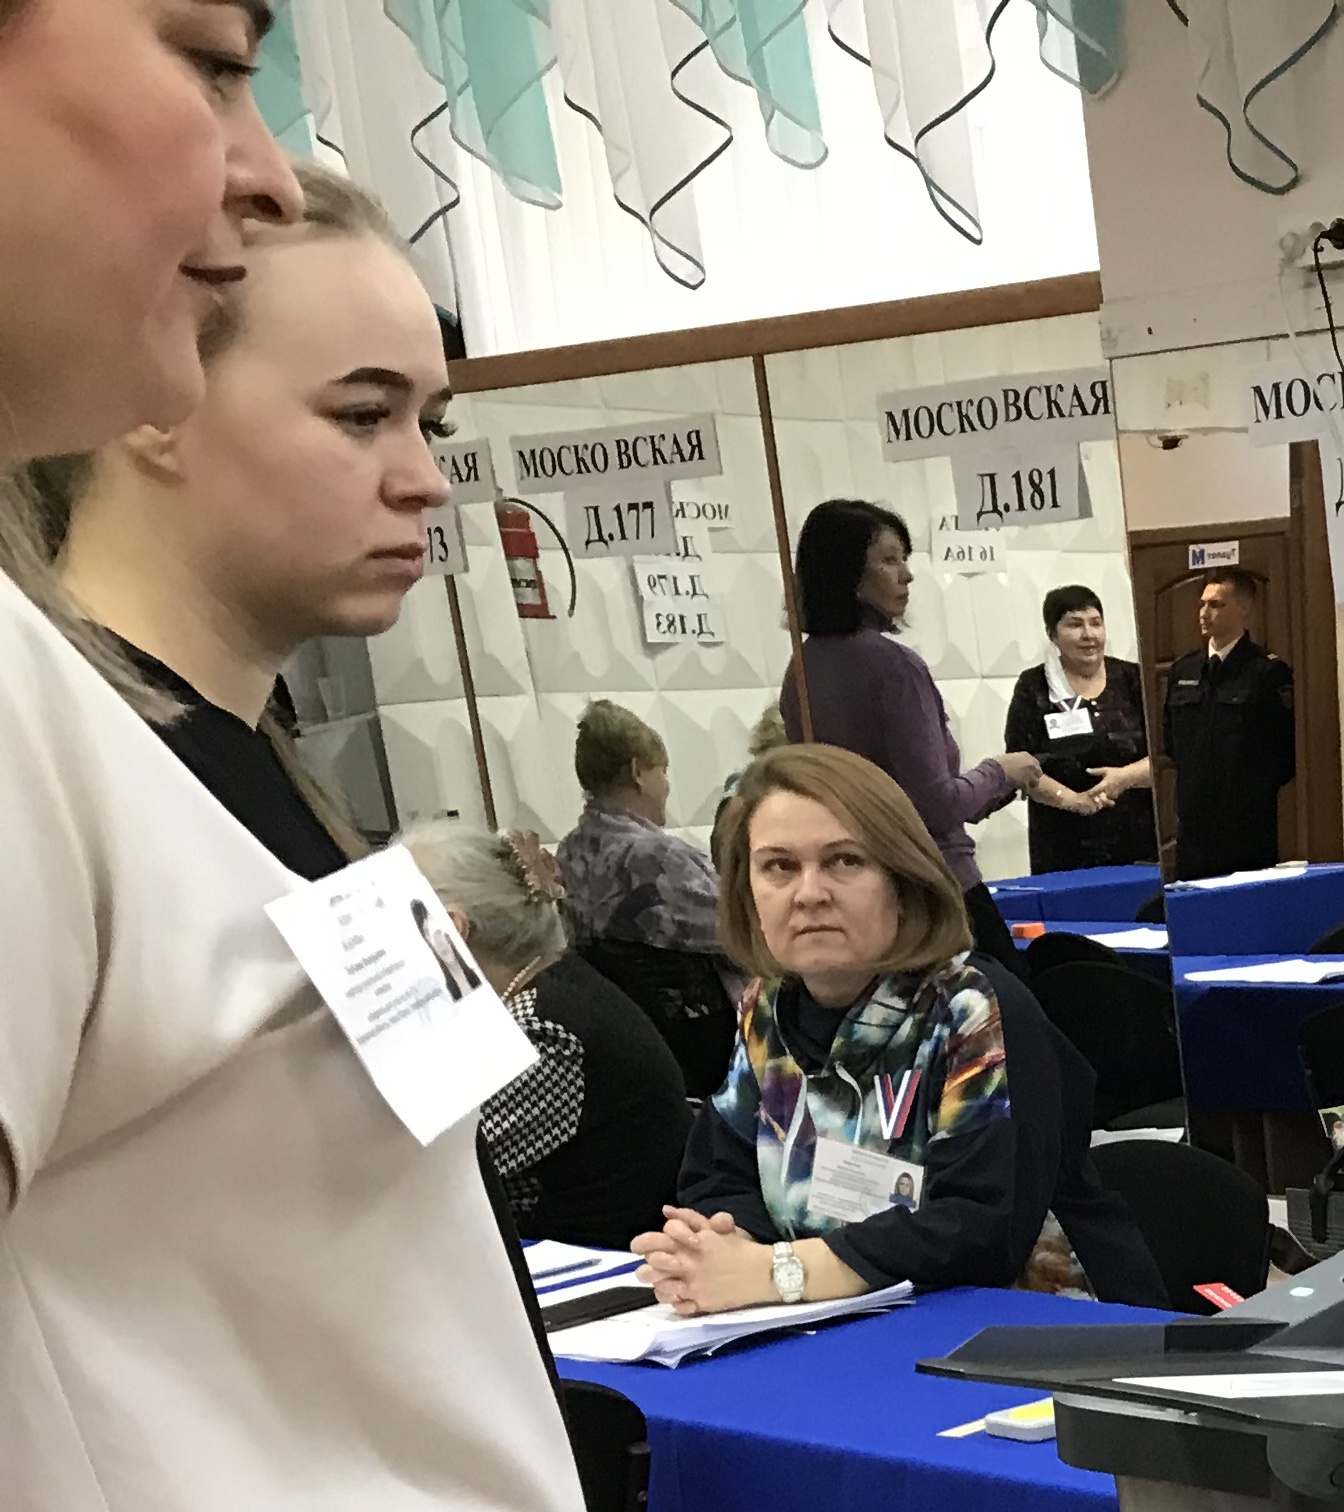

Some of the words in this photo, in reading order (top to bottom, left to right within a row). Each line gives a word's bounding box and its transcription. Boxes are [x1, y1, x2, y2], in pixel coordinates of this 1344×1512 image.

[885, 380, 1112, 443] МОСКОВСКАЯ
[584, 500, 656, 551] Д.177
[976, 467, 1061, 526] Д.181
